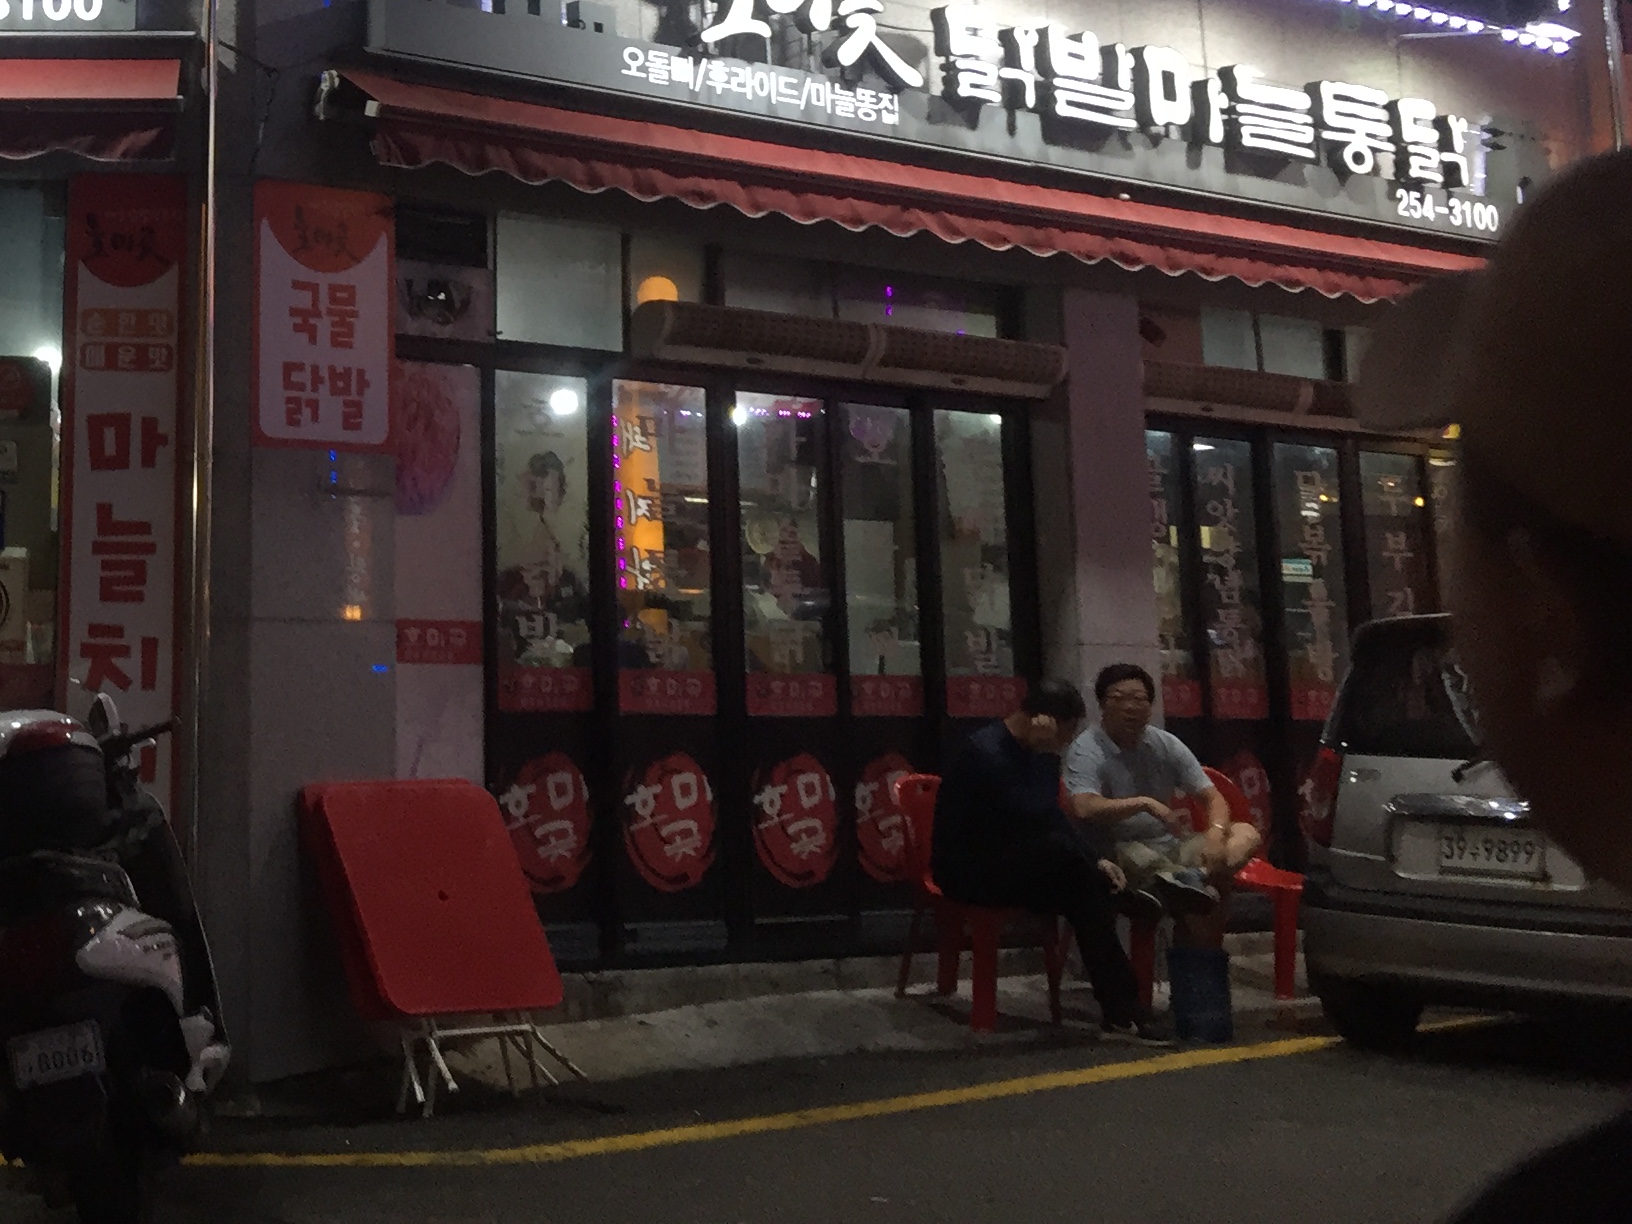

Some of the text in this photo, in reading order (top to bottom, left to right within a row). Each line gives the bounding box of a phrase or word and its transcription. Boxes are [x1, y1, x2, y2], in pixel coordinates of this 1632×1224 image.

[1396, 187, 1499, 232] 254-3100
[288, 278, 359, 350] 국물
[282, 360, 371, 432] 닭발
[79, 412, 169, 784] 마늘치
